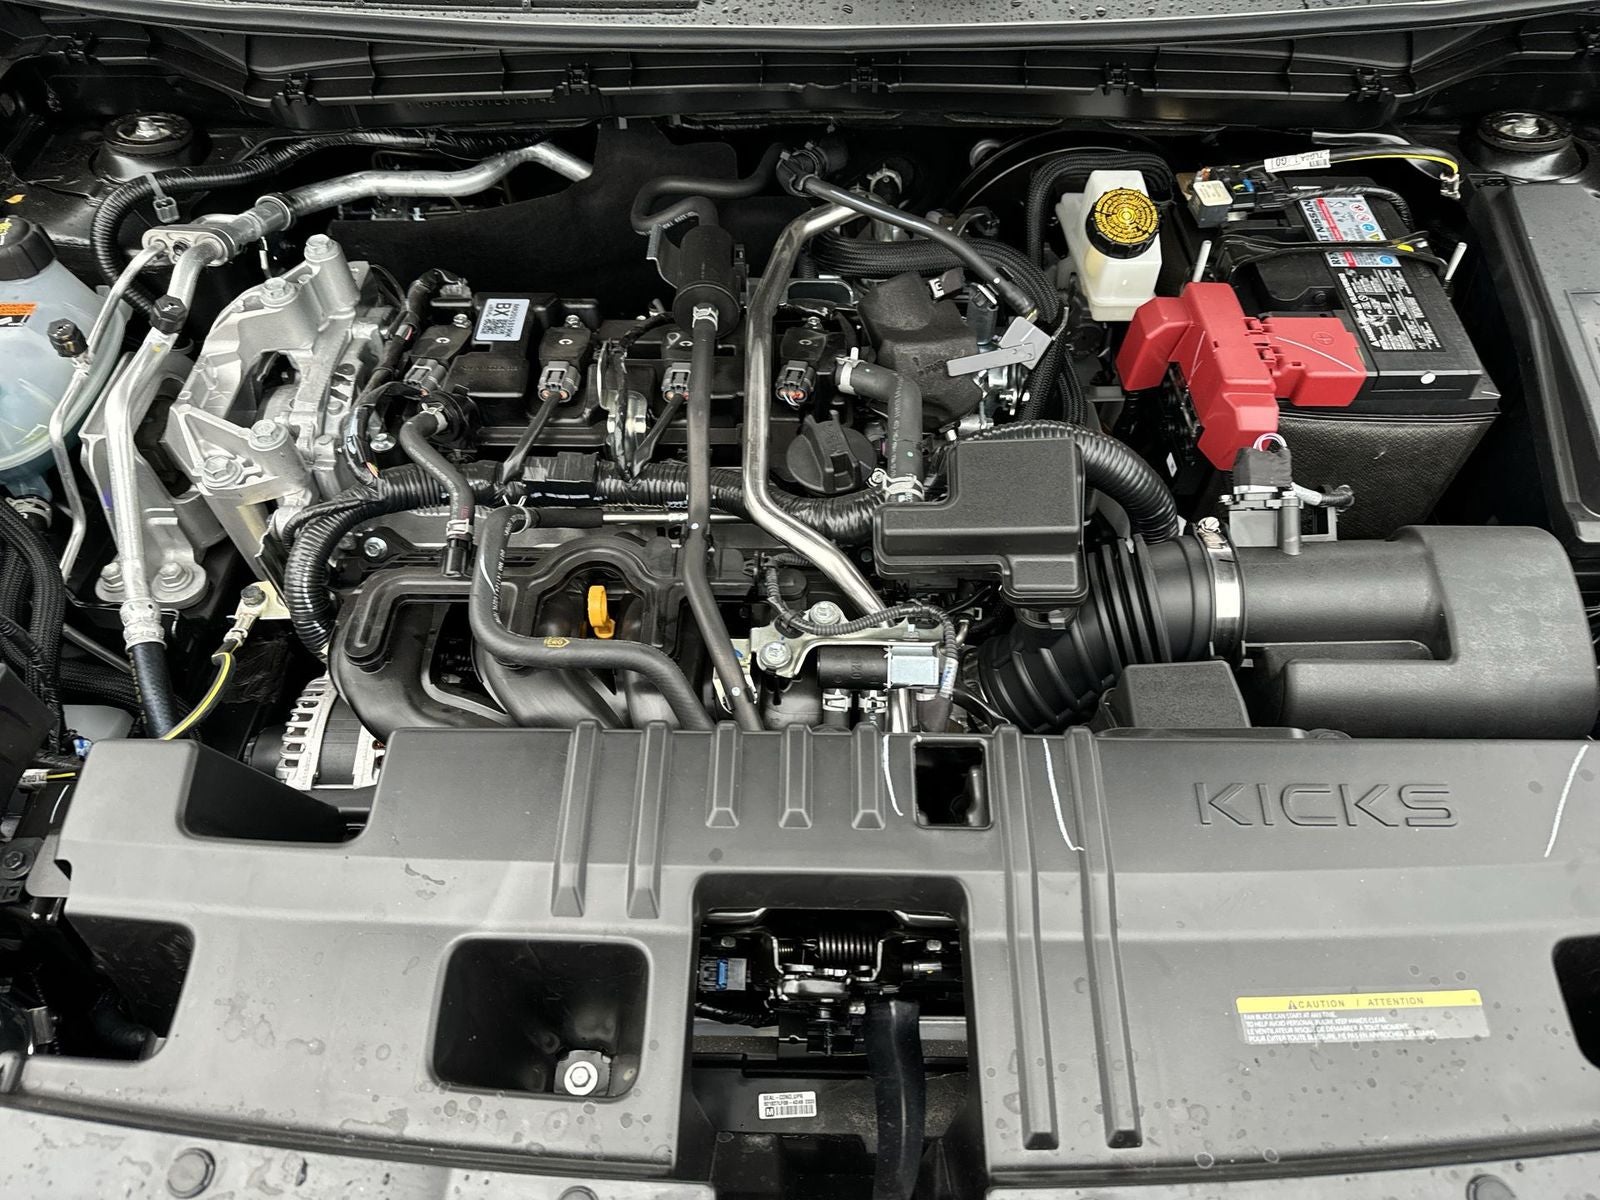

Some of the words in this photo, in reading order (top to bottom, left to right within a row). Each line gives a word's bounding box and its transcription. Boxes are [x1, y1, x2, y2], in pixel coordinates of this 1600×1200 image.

[1303, 200, 1327, 233] NISSAN
[493, 302, 512, 316] BX
[1194, 782, 1458, 828] KICKS
[1298, 1000, 1345, 1009] CAUTION
[1368, 997, 1424, 1006] ATTENTION
